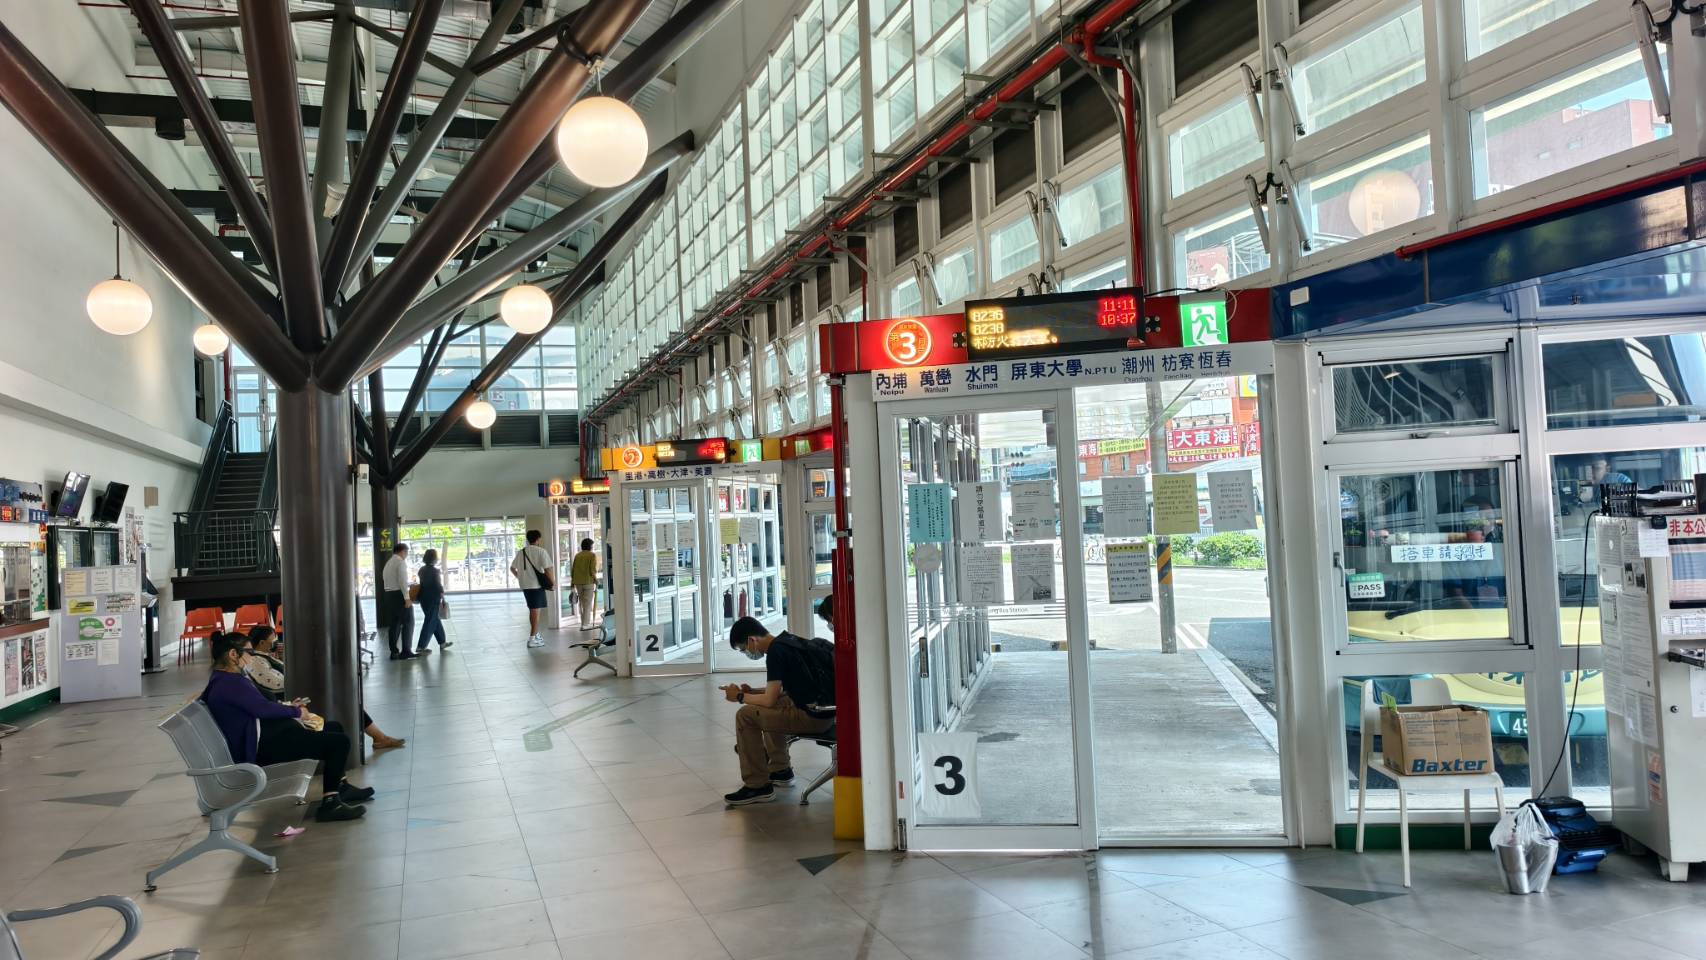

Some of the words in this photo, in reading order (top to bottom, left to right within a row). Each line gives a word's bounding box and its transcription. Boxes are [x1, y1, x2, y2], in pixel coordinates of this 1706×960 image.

[1103, 298, 1136, 312] 11:11
[972, 310, 1003, 322] 8236
[973, 322, 1005, 335] 8238
[899, 332, 917, 360] 3
[919, 368, 952, 387] 萬巒
[965, 364, 998, 383] 水門
[1011, 358, 1083, 381] 屏東大學
[1121, 355, 1155, 375] 潮州
[1162, 353, 1195, 372] 枋寮
[1198, 350, 1232, 369] 恆春
[1175, 428, 1231, 448] 大東海
[628, 452, 636, 465] 2
[645, 634, 660, 652] 2
[1411, 758, 1488, 773] Baxter
[933, 755, 966, 796] 3
